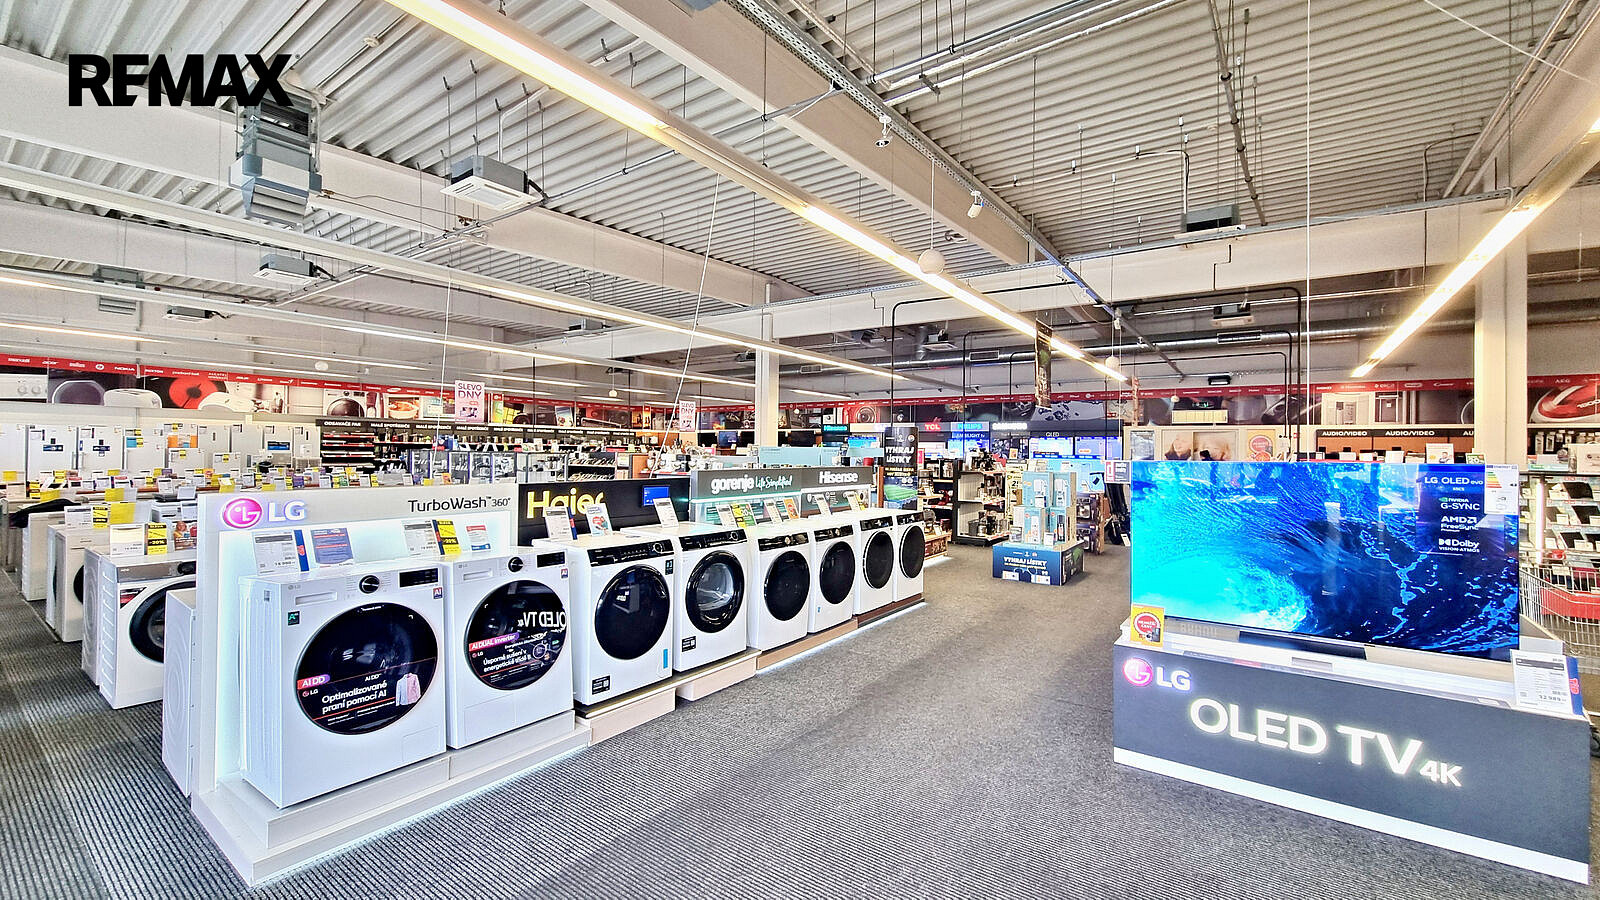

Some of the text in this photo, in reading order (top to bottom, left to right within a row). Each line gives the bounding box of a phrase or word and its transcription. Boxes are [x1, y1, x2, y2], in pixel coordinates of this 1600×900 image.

[458, 383, 482, 391] SLEVO
[458, 391, 481, 399] DNY
[711, 475, 754, 494] gorenje
[819, 470, 859, 484] Hisense
[268, 500, 305, 521] LG
[526, 487, 604, 518] Haier
[1441, 523, 1479, 531] FreeSync
[1451, 539, 1480, 548] Dolby
[478, 640, 494, 648] DUAL
[302, 676, 326, 687] AI DD
[1156, 667, 1191, 691] LG
[321, 680, 388, 704] Optimalizované
[322, 702, 346, 715] praní
[346, 693, 377, 708] pomocí
[377, 689, 387, 698] AI
[1190, 698, 1463, 787] OLED TV 4K
